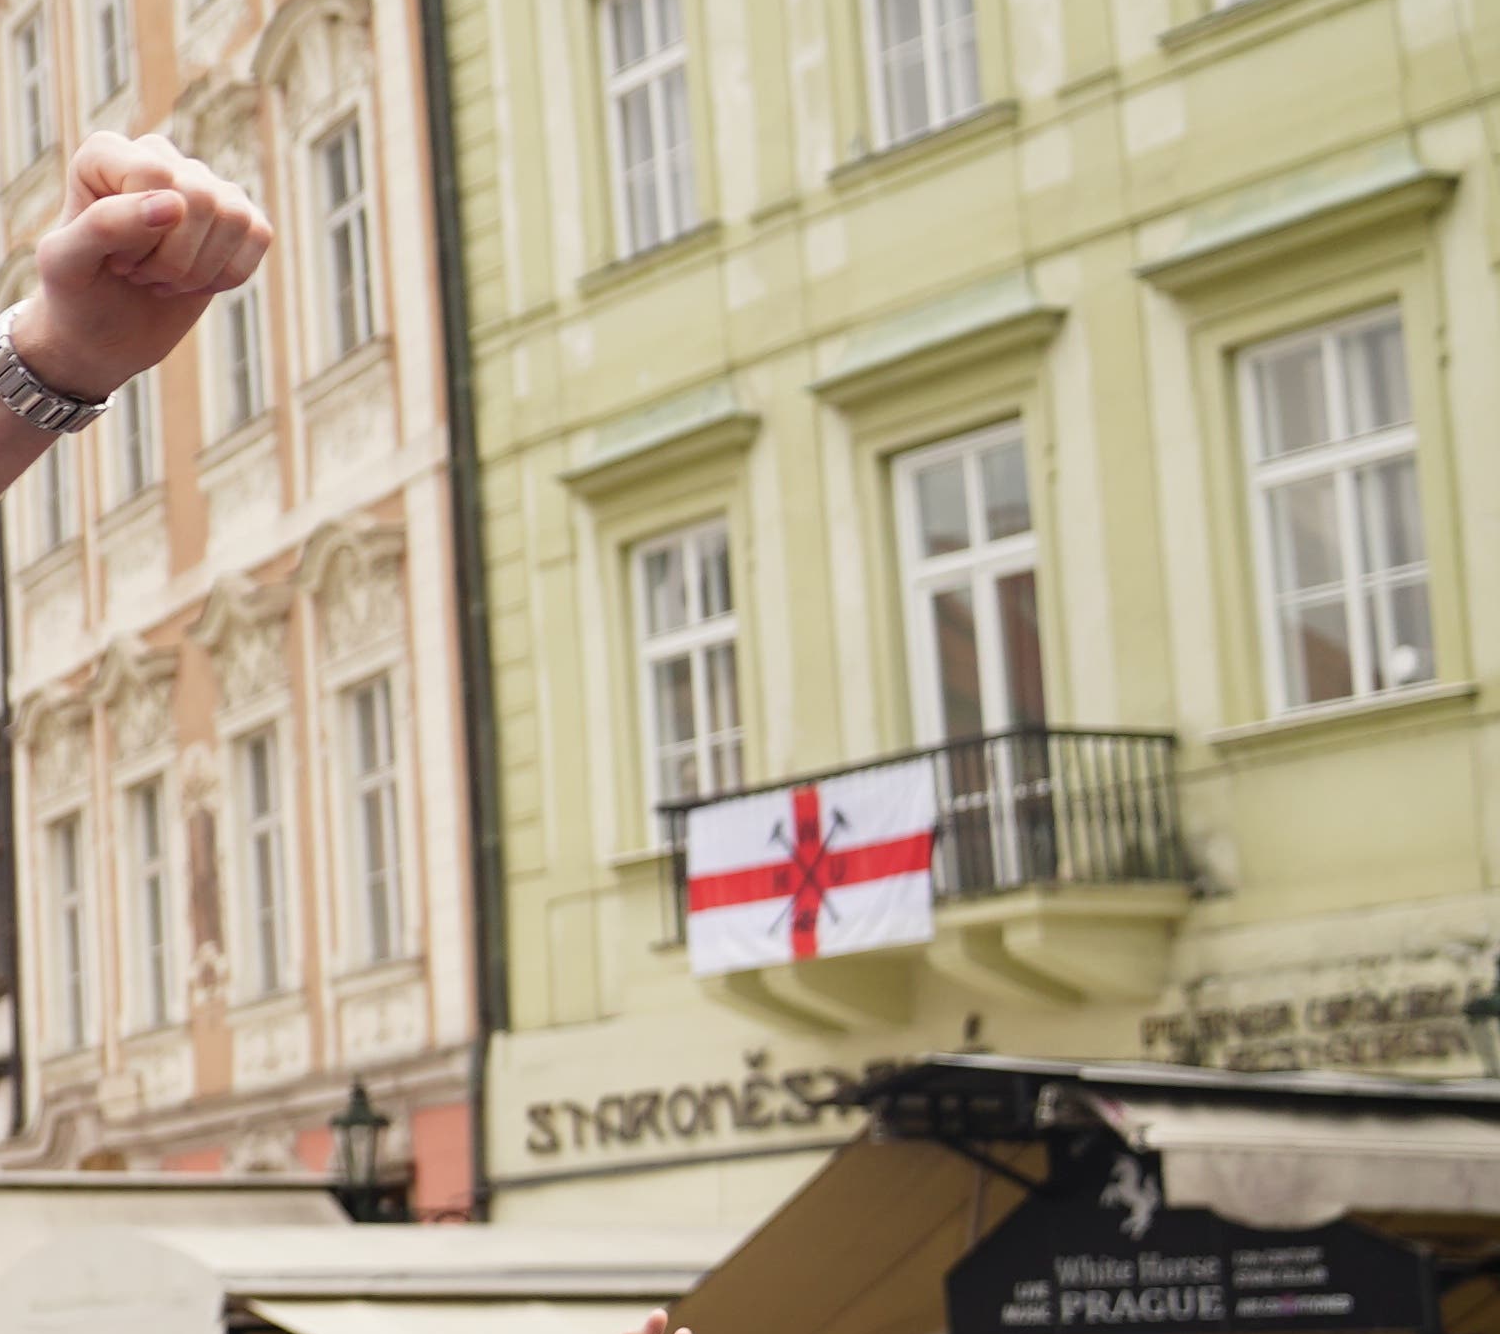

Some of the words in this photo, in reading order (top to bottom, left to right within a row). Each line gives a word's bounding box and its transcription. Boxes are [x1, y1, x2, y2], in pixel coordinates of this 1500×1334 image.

[1053, 1254, 1137, 1287] White
[1138, 1251, 1222, 1285] Horse
[1058, 1285, 1227, 1326] PRAGUE
